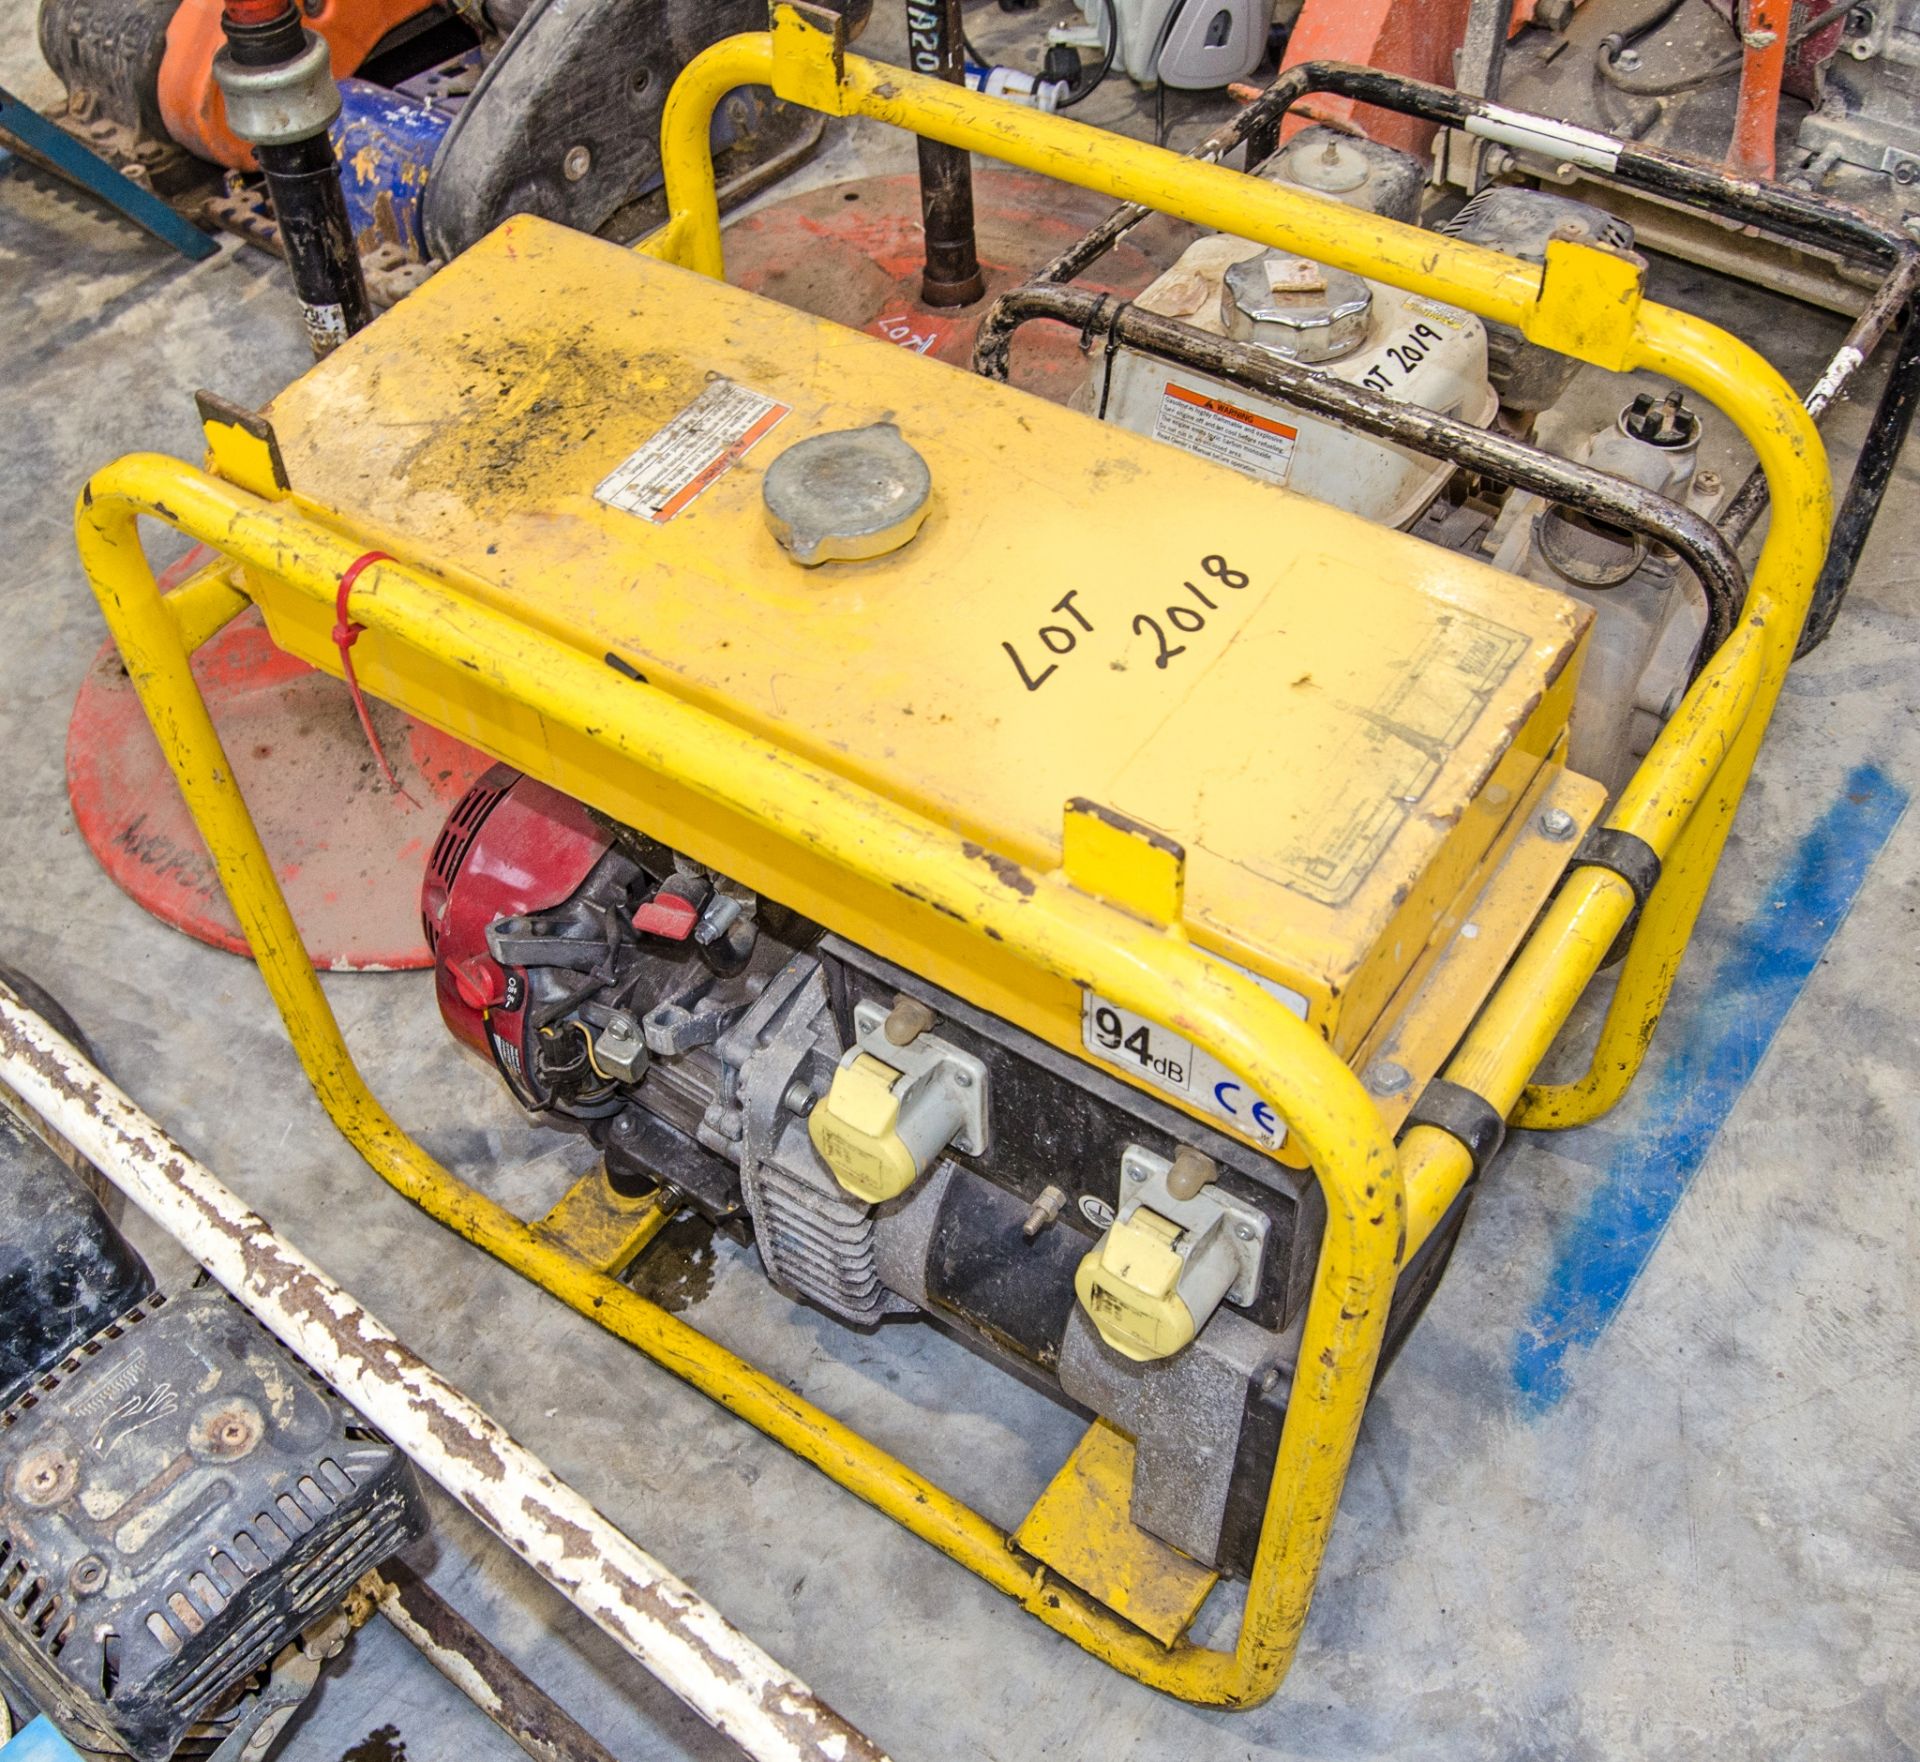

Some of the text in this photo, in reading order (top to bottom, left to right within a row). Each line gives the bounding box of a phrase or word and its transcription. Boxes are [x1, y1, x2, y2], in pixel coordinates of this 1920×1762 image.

[907, 0, 940, 71] A20
[1386, 323, 1443, 374] 2019
[1217, 403, 1254, 424] WARNING
[1001, 555, 1250, 691] LOT 2018
[1095, 1007, 1184, 1084] 94dB
